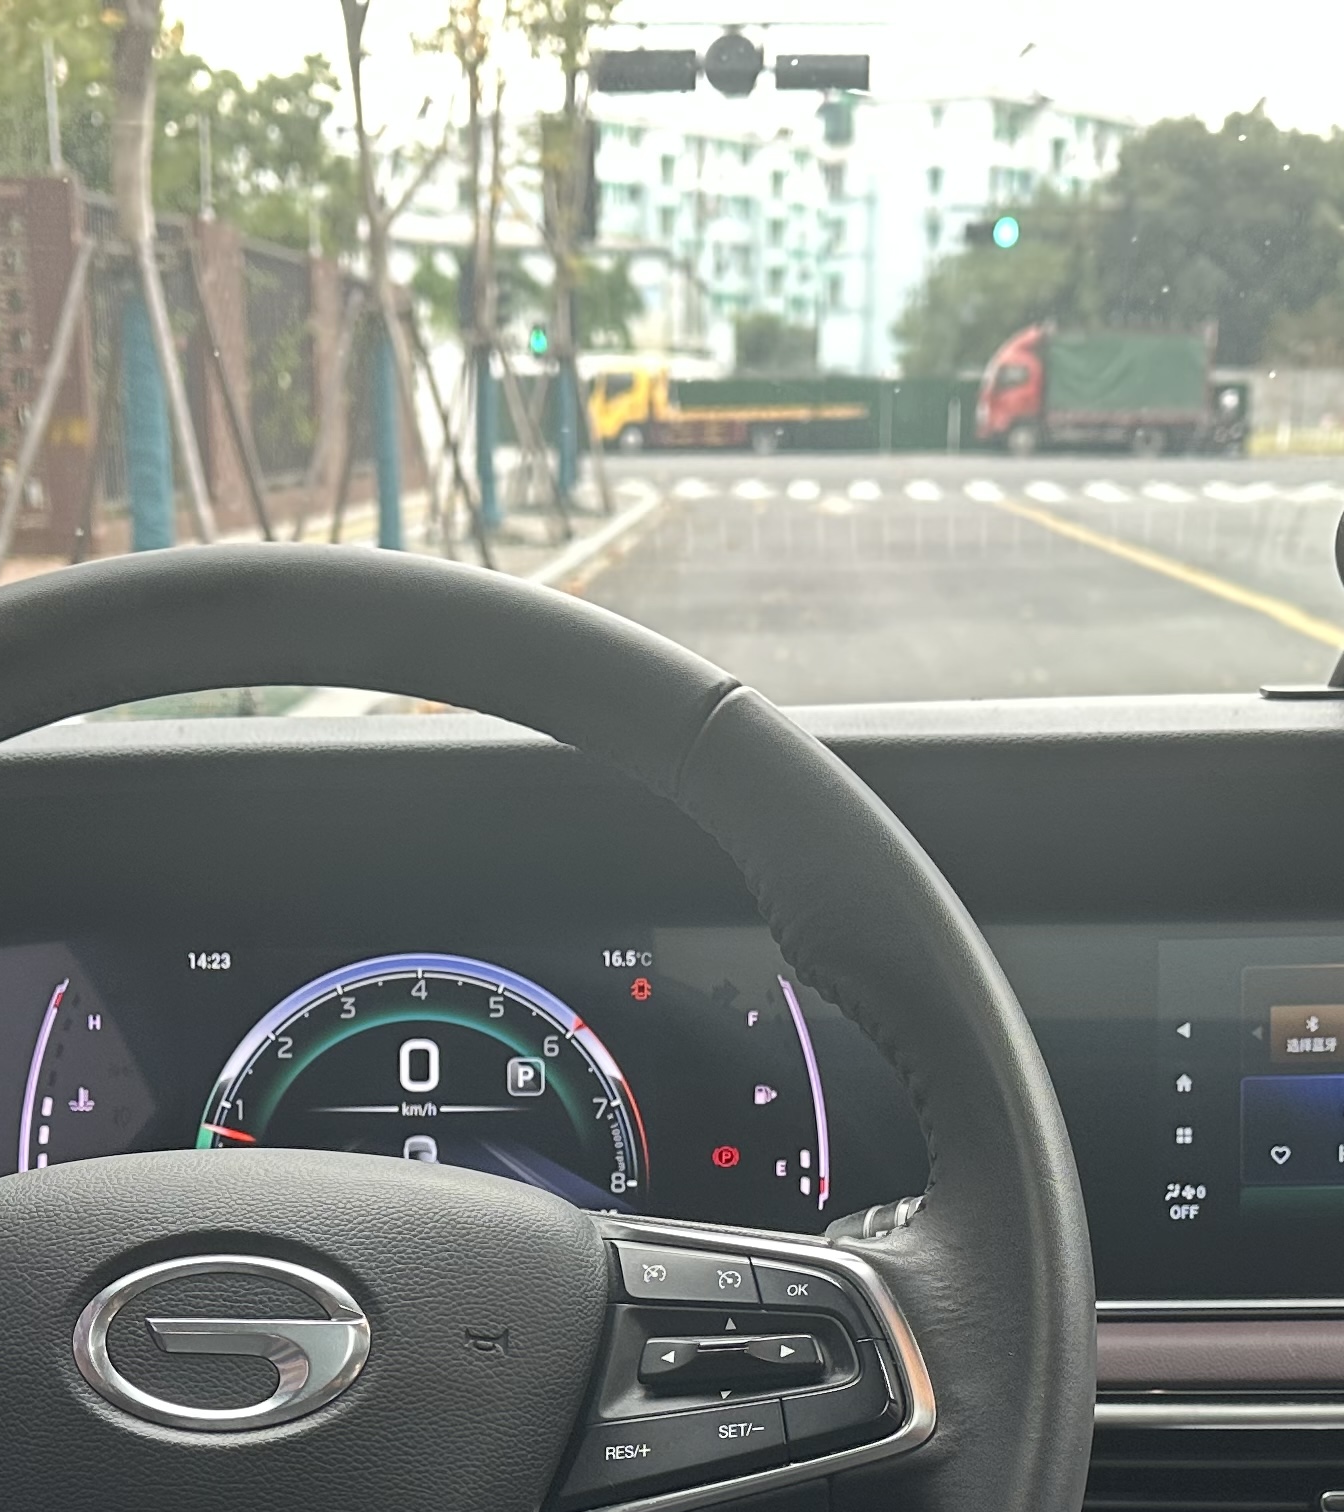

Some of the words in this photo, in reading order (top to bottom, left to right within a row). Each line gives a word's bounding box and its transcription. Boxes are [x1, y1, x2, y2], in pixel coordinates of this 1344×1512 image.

[188, 952, 232, 970] 14:23
[410, 979, 428, 1000] 4
[340, 997, 357, 1019] 3
[489, 996, 505, 1018] 5
[87, 1014, 101, 1031] H
[747, 1010, 759, 1027] F
[277, 1037, 294, 1059] 2
[543, 1035, 560, 1057] 6
[1286, 1037, 1338, 1053] 选择蓝牙
[399, 1038, 440, 1093] 0
[517, 1065, 534, 1089] P
[235, 1098, 244, 1120] 1
[401, 1102, 438, 1117] km/h
[591, 1097, 609, 1119] 7
[774, 1159, 788, 1177] E
[610, 1172, 626, 1193] 8
[1169, 1204, 1200, 1220] OFF
[786, 1284, 809, 1297] OK
[605, 1443, 652, 1461] RES/+
